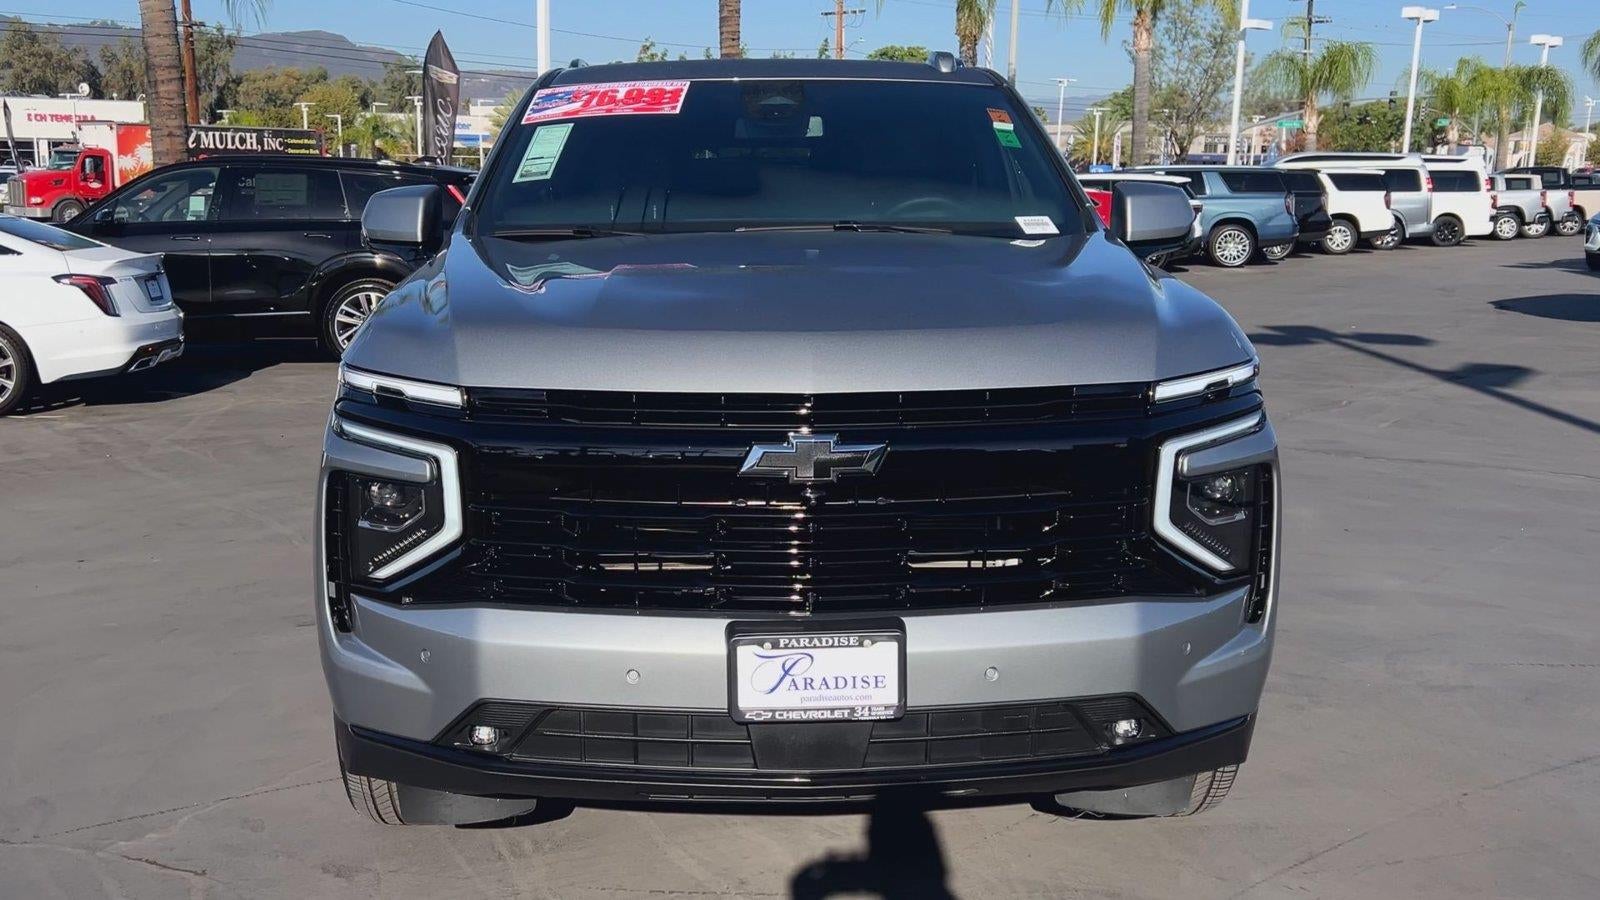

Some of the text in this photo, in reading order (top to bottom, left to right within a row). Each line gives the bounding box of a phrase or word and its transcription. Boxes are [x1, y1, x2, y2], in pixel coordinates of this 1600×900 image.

[200, 131, 262, 152] MULCH,
[779, 636, 860, 648] PARADISE
[751, 651, 887, 695] PARADISE
[800, 694, 873, 704] paradiseautos.com
[775, 709, 851, 720] CHEVROLET
[853, 706, 870, 717] 34
